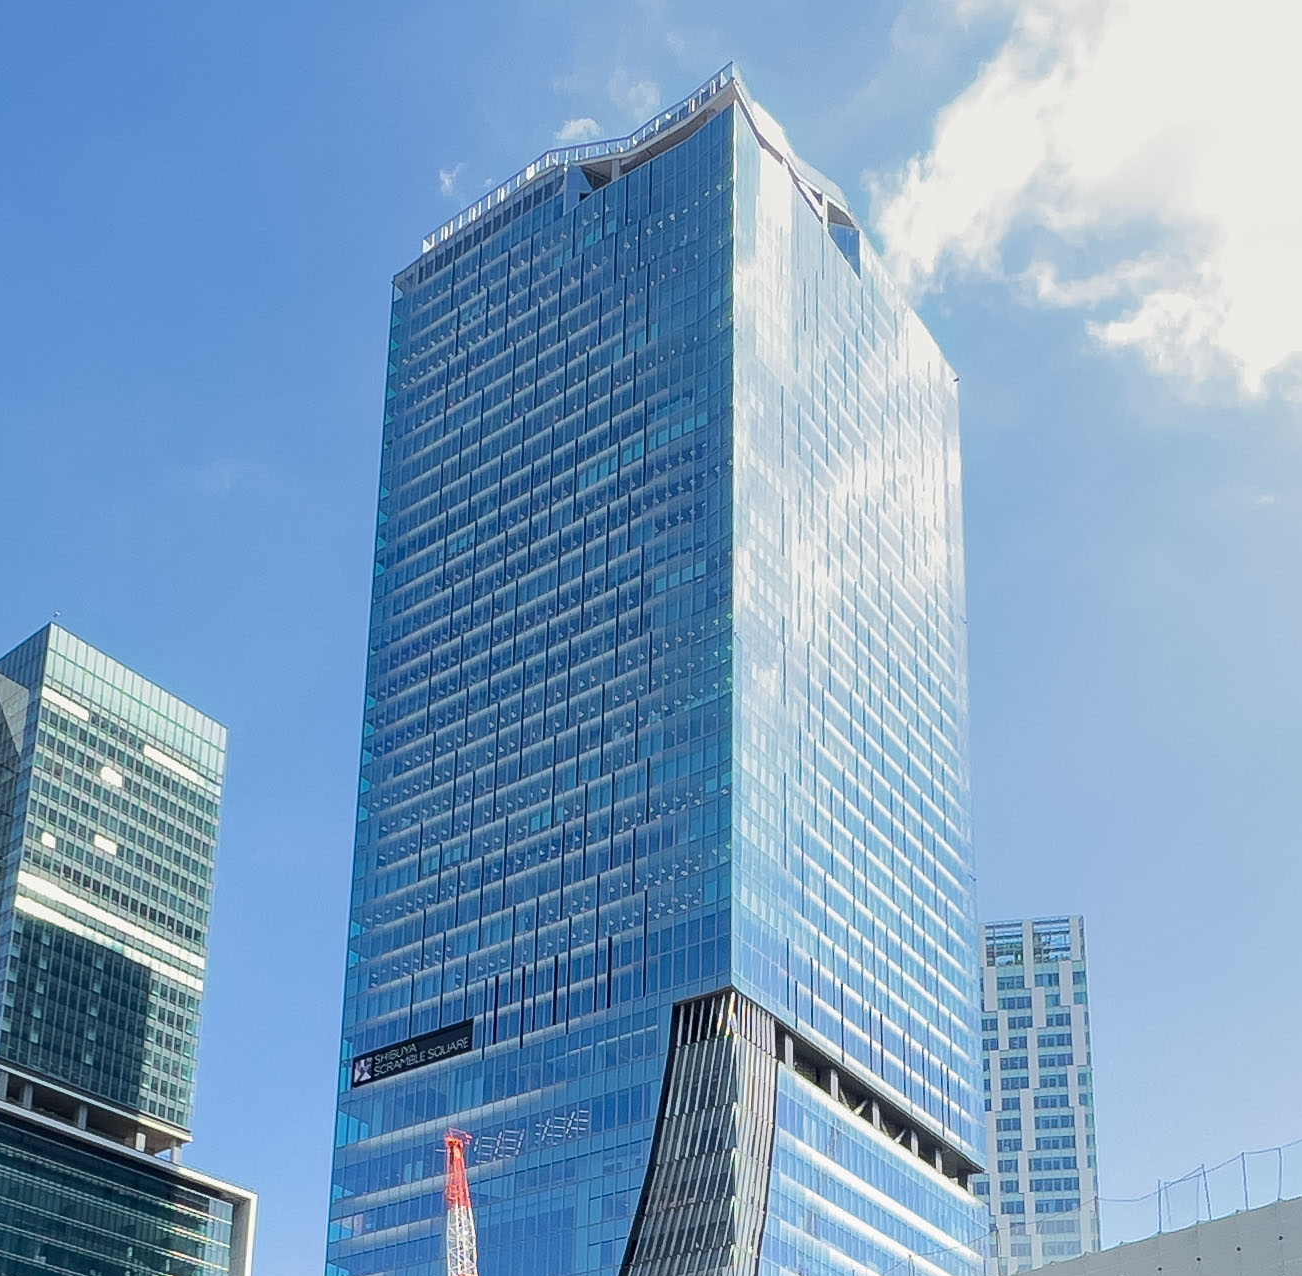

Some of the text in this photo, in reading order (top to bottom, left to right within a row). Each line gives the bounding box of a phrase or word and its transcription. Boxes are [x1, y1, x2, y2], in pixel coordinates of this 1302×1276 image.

[373, 1036, 469, 1077] SCRAMBLE SQUARE
[374, 1043, 418, 1065] SHIBUYA
